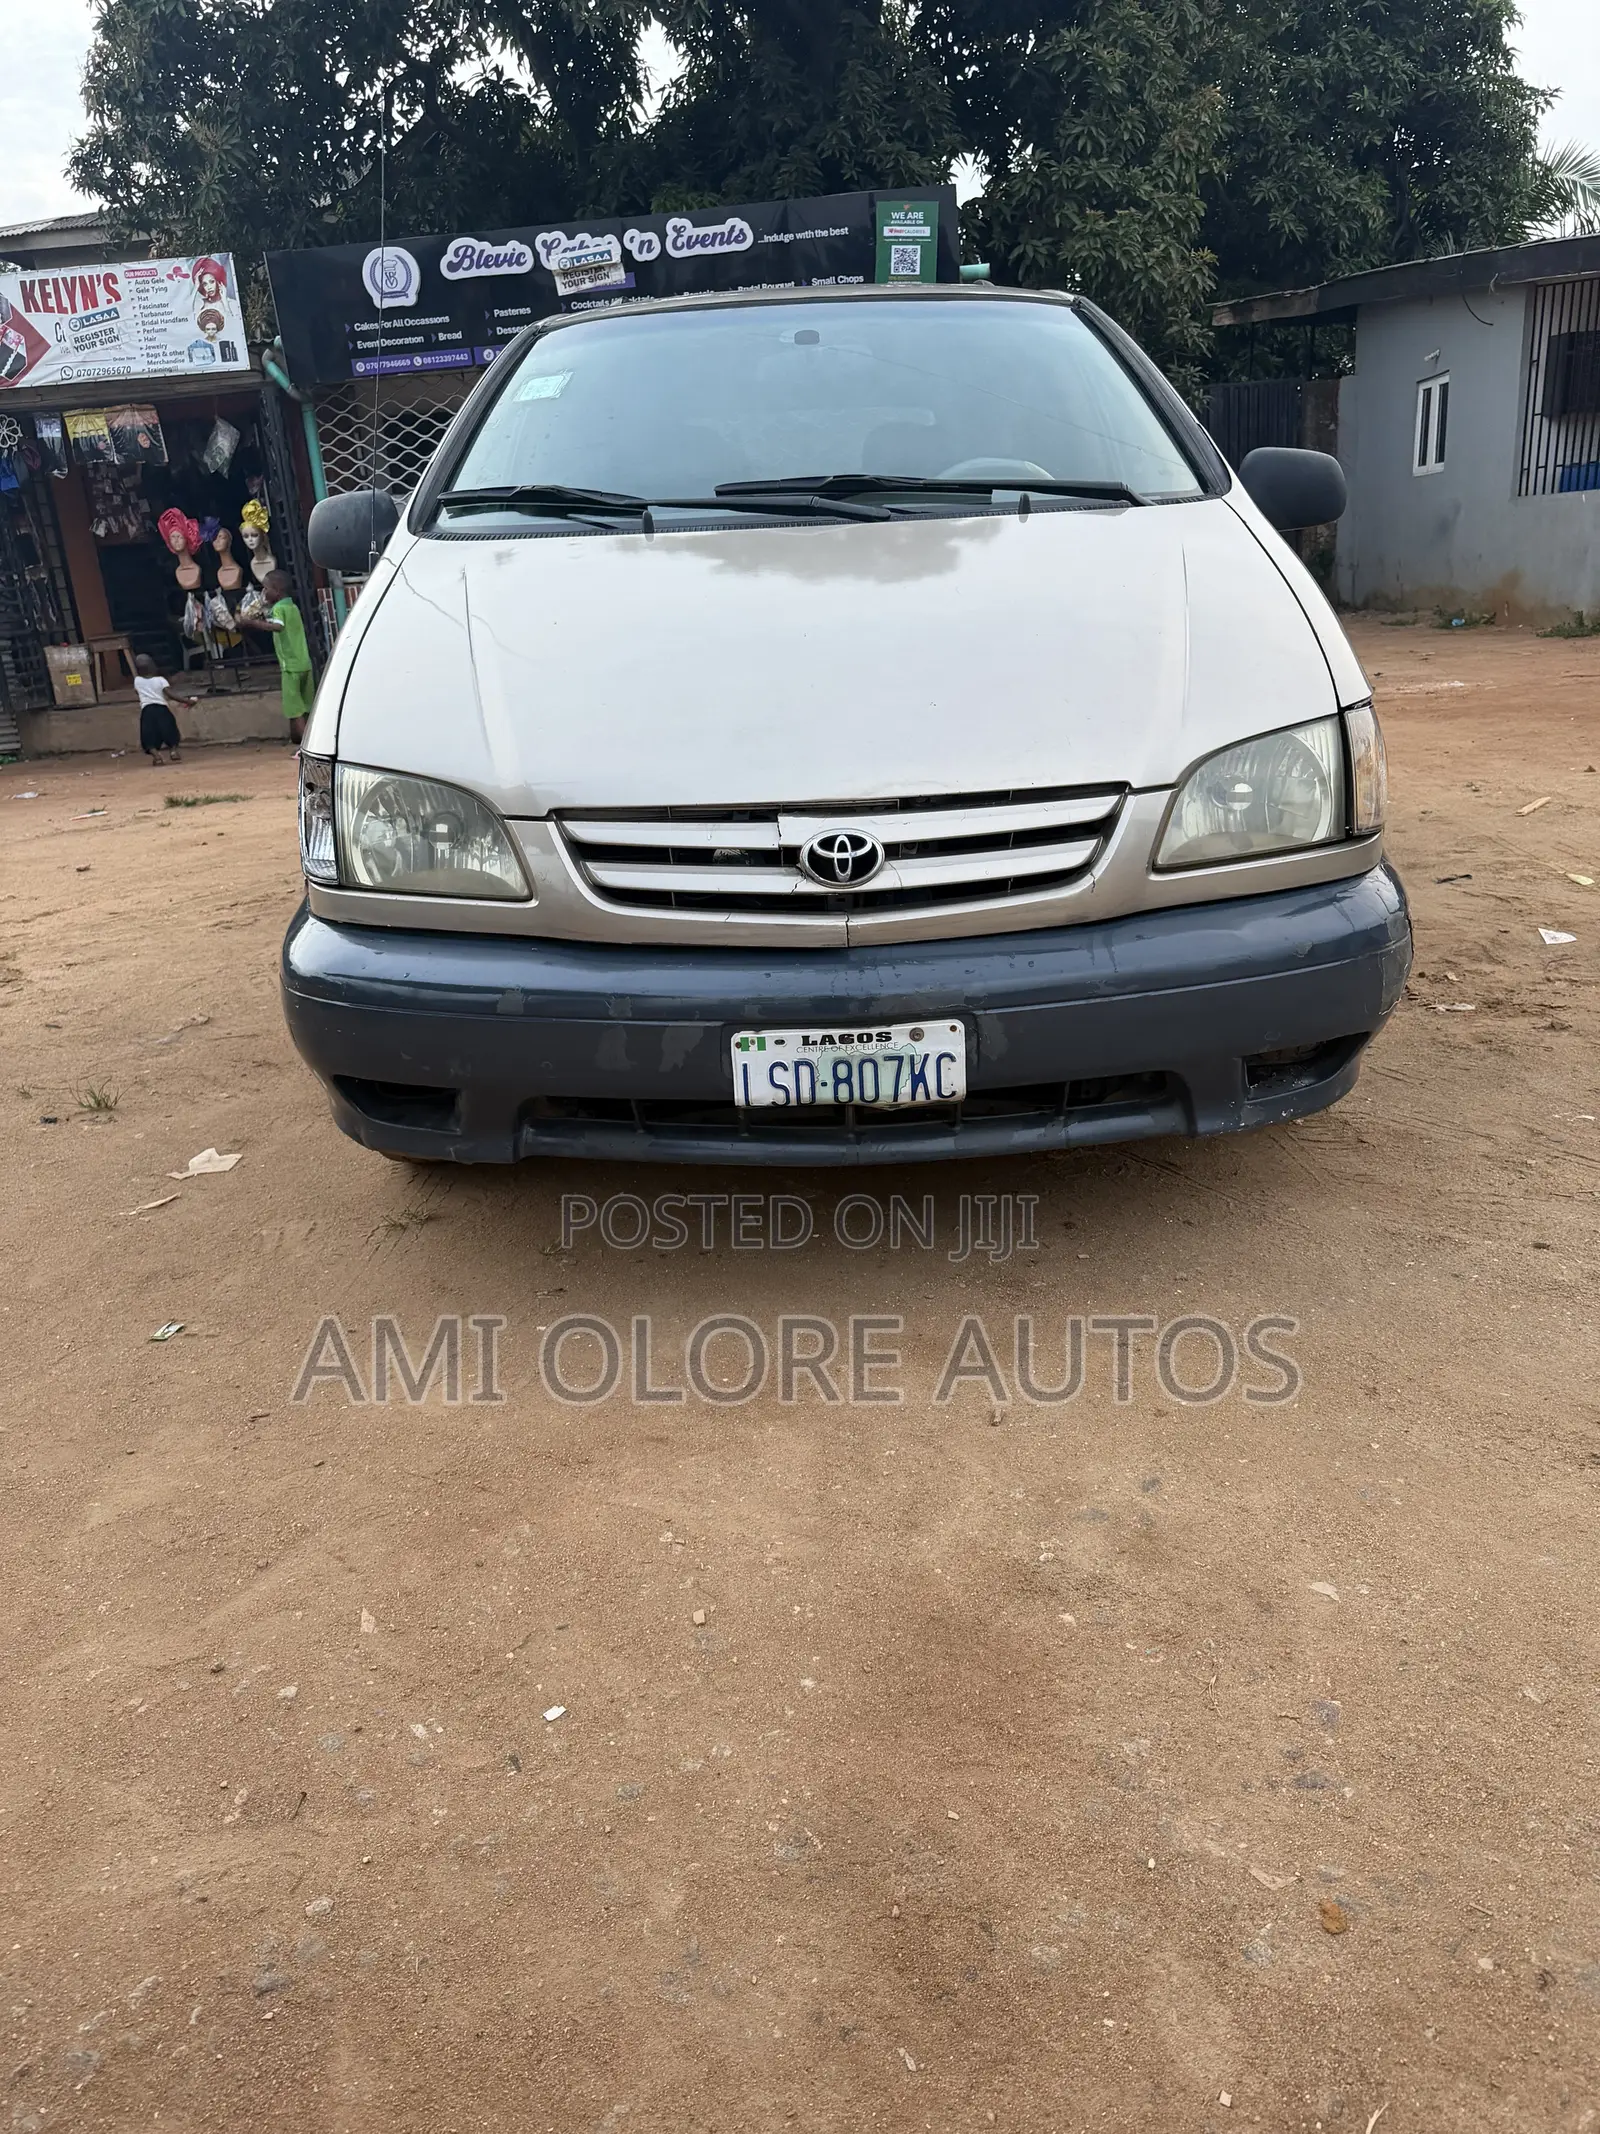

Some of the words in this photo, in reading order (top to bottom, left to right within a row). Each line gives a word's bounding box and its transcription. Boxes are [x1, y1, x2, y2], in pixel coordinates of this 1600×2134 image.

[891, 211, 906, 220] WE
[906, 211, 924, 220] ARE
[795, 229, 814, 240] with
[814, 228, 829, 238] the
[829, 226, 849, 236] best
[446, 244, 528, 273] Blevic
[671, 224, 748, 251] Events
[573, 253, 611, 266] LASAA
[562, 266, 605, 280] REGISTER
[562, 277, 586, 289] YOUR
[588, 271, 610, 283] SIGN
[811, 276, 836, 286] Small
[837, 274, 864, 285] Chops
[19, 272, 122, 314] KELYN'S
[138, 302, 169, 310] Fascinator
[571, 298, 610, 310] Cocktails
[82, 310, 118, 325] LASAA
[140, 310, 173, 318] Turbanator
[160, 316, 189, 324] Handfans
[354, 322, 379, 332] Cakes
[392, 319, 404, 328] All
[404, 315, 450, 327] Occassions
[73, 327, 115, 344] REGISTER
[438, 330, 463, 341] Bread
[73, 341, 97, 353] YOUR
[99, 335, 120, 346] SIGN
[144, 343, 168, 351] Jewelry
[356, 340, 380, 350] Event
[380, 335, 424, 347] Decoration
[146, 358, 185, 366] Merchandise
[76, 365, 132, 377] 07072965670
[801, 1031, 893, 1046] LAGOS
[796, 1045, 828, 1054] CENTRE
[830, 1044, 843, 1053] OF
[844, 1041, 899, 1052] EXCELLENCE
